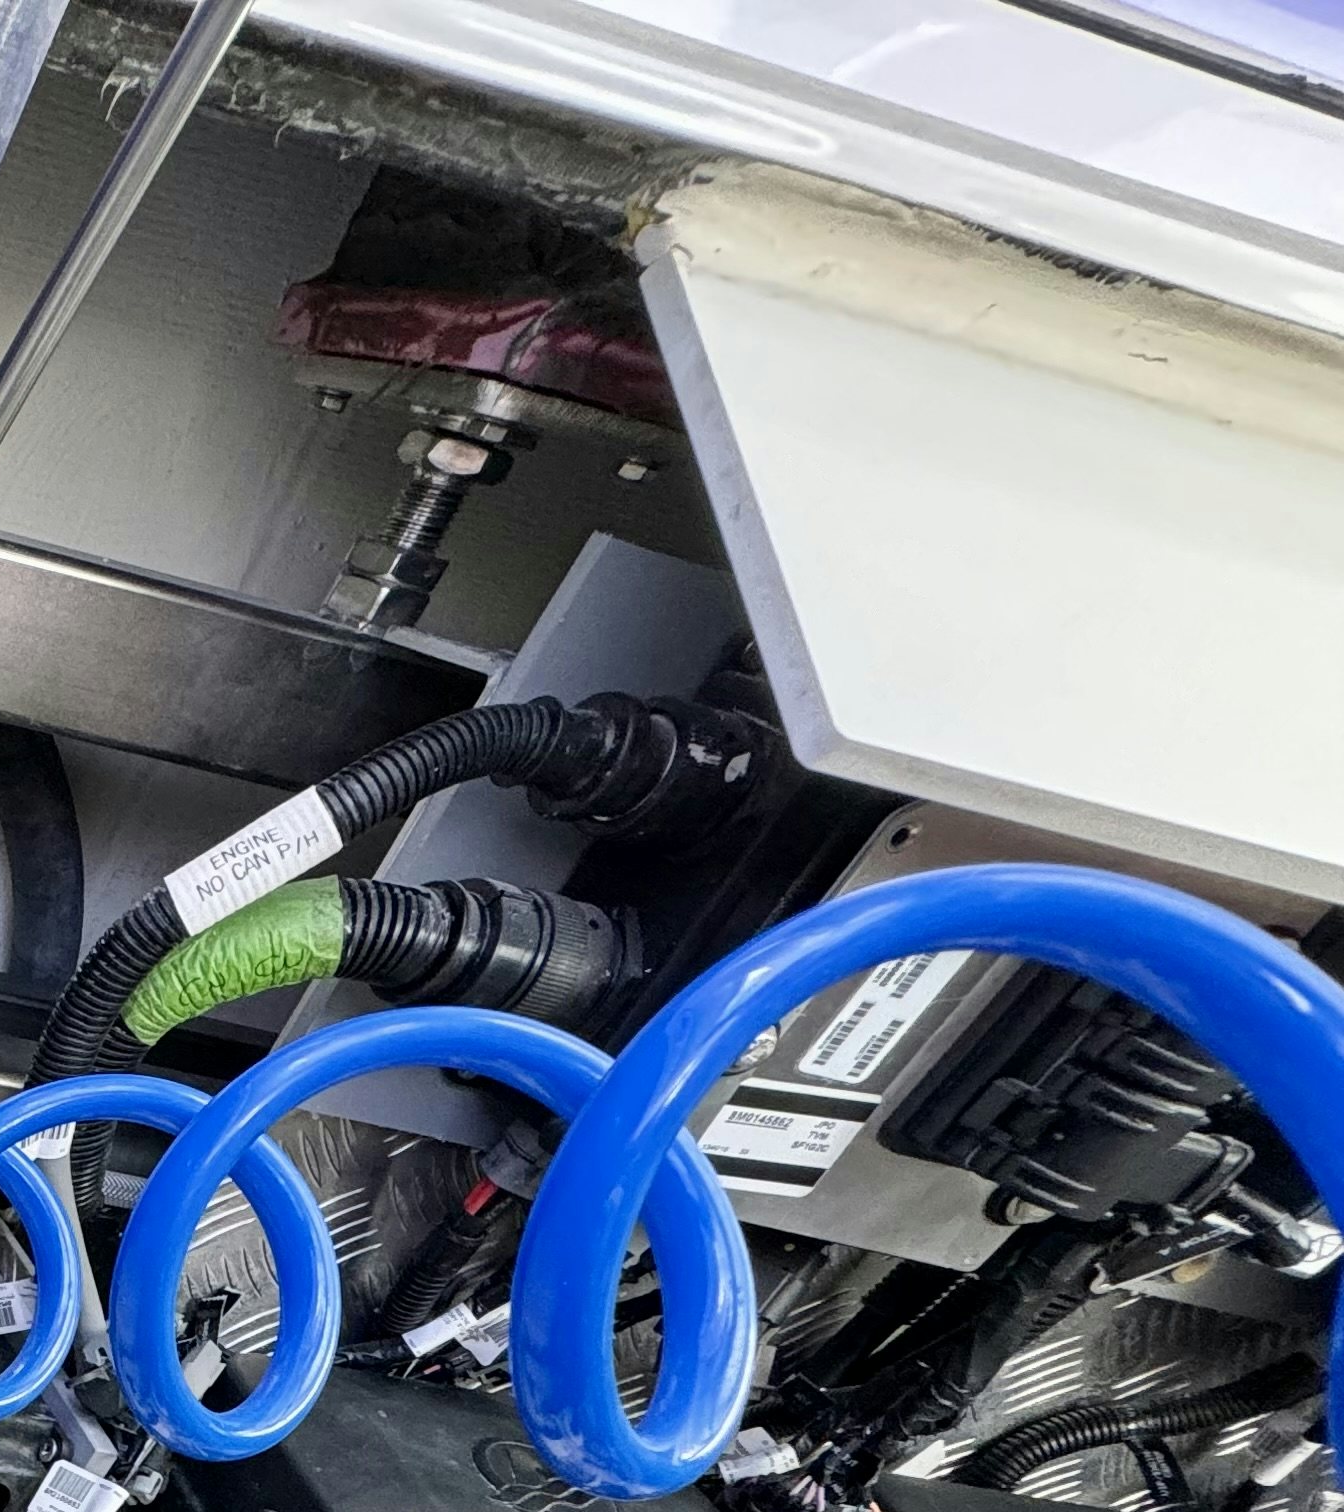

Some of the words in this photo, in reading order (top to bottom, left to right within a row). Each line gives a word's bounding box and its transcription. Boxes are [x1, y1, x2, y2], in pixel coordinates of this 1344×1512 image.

[209, 827, 284, 871] ENGINE
[196, 875, 225, 902] NO
[231, 850, 272, 881] CAN
